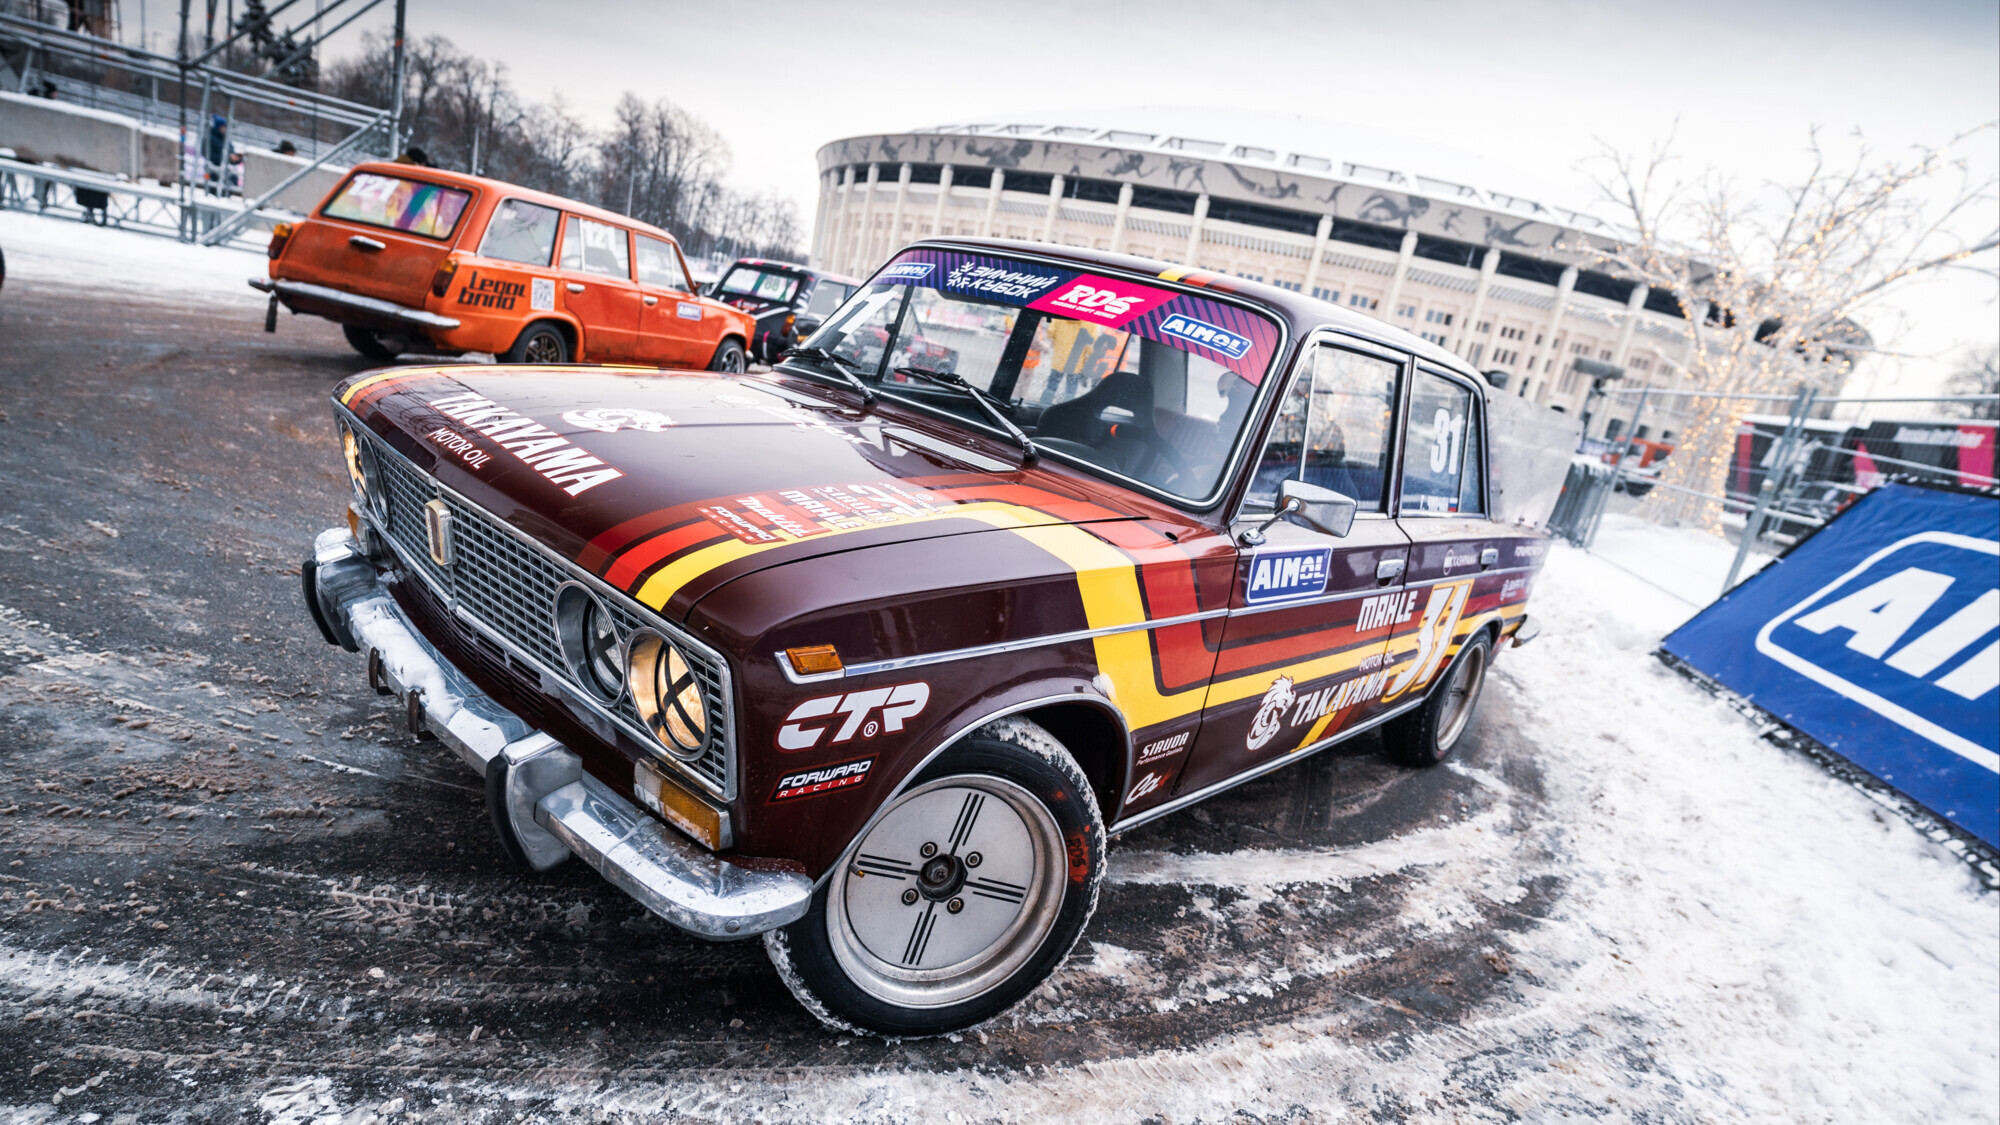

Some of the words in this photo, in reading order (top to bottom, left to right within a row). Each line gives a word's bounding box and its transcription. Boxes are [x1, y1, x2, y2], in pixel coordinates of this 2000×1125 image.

[349, 173, 401, 201] 121
[967, 278, 1040, 299] КУБОК
[974, 266, 1059, 289] ЗИМНИЙ
[1057, 284, 1146, 315] RDS
[1164, 318, 1243, 355] AIMOL
[429, 391, 625, 497] TAKAYAMA
[432, 427, 469, 456] MOTOR
[463, 448, 491, 470] OIL
[1430, 407, 1463, 475] 31
[700, 508, 756, 540] RACING
[709, 506, 777, 540] FORWARD
[778, 490, 865, 529] MAHLE
[1251, 555, 1326, 592] AIMOL
[1355, 590, 1418, 632] MAHLE
[1386, 583, 1471, 697] 31
[1792, 566, 2000, 701] AI
[1358, 653, 1383, 672] MOTOR
[1290, 668, 1392, 728] TAKAYAMA
[778, 760, 872, 790] FORWARD
[779, 775, 863, 798] RACING
